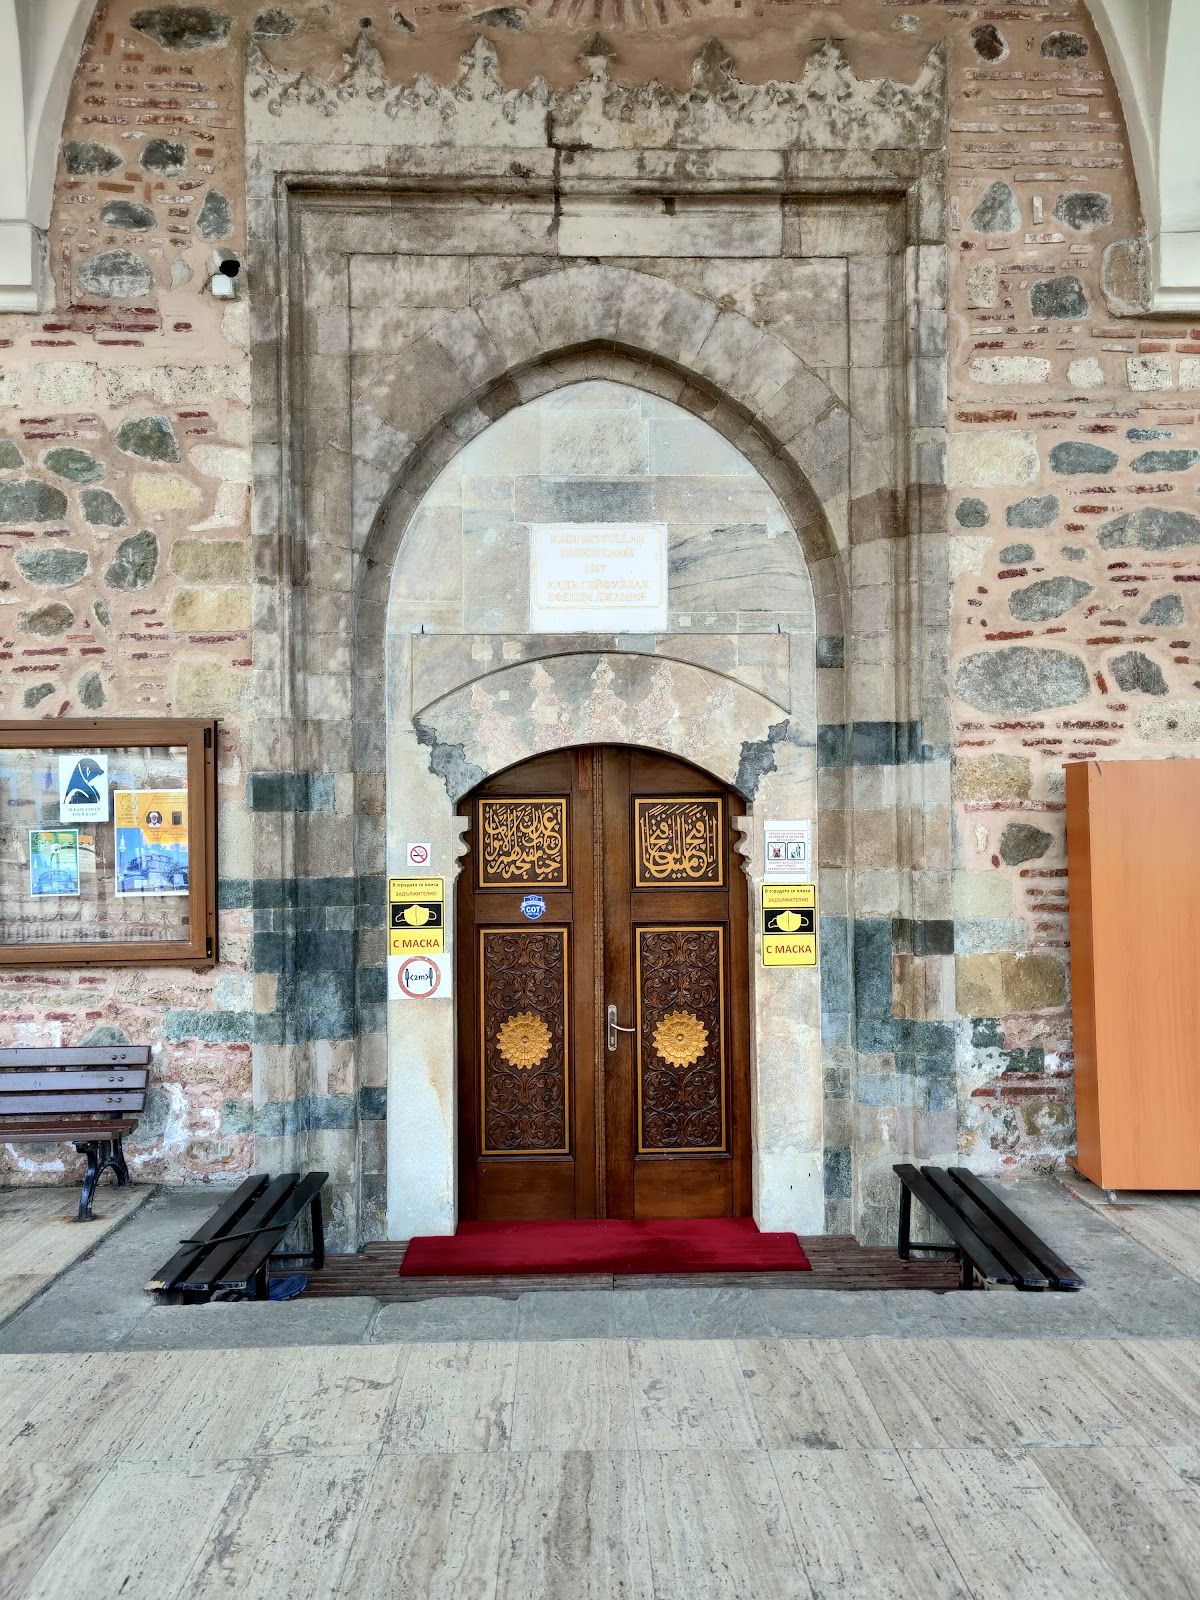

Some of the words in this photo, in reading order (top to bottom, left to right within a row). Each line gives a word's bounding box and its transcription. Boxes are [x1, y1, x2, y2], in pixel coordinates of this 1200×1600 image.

[393, 939, 400, 948] С
[402, 939, 440, 948] МАСКА
[766, 945, 772, 954] С
[775, 944, 812, 954] МАСКА
